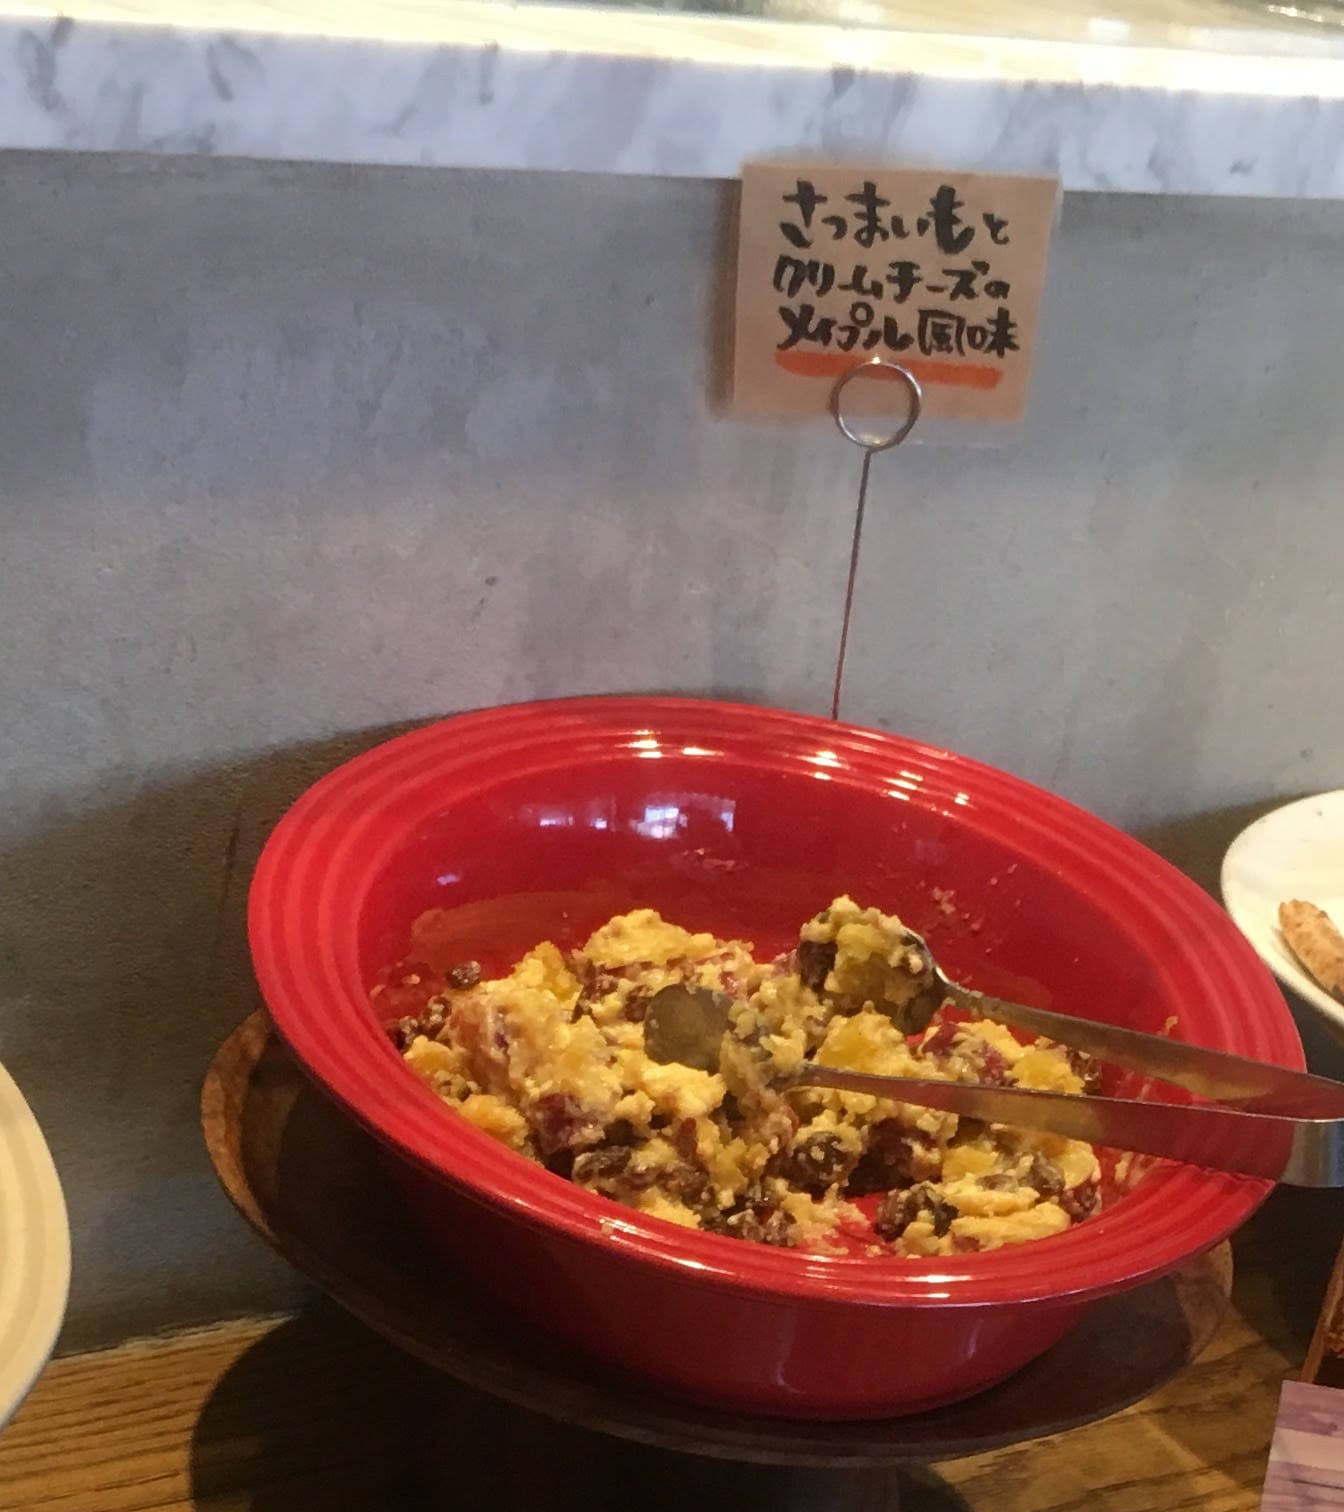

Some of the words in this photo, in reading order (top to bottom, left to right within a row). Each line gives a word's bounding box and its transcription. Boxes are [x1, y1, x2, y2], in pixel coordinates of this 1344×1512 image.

[778, 179, 1011, 254] さつまいもと
[772, 254, 1011, 304] クリームチーズの
